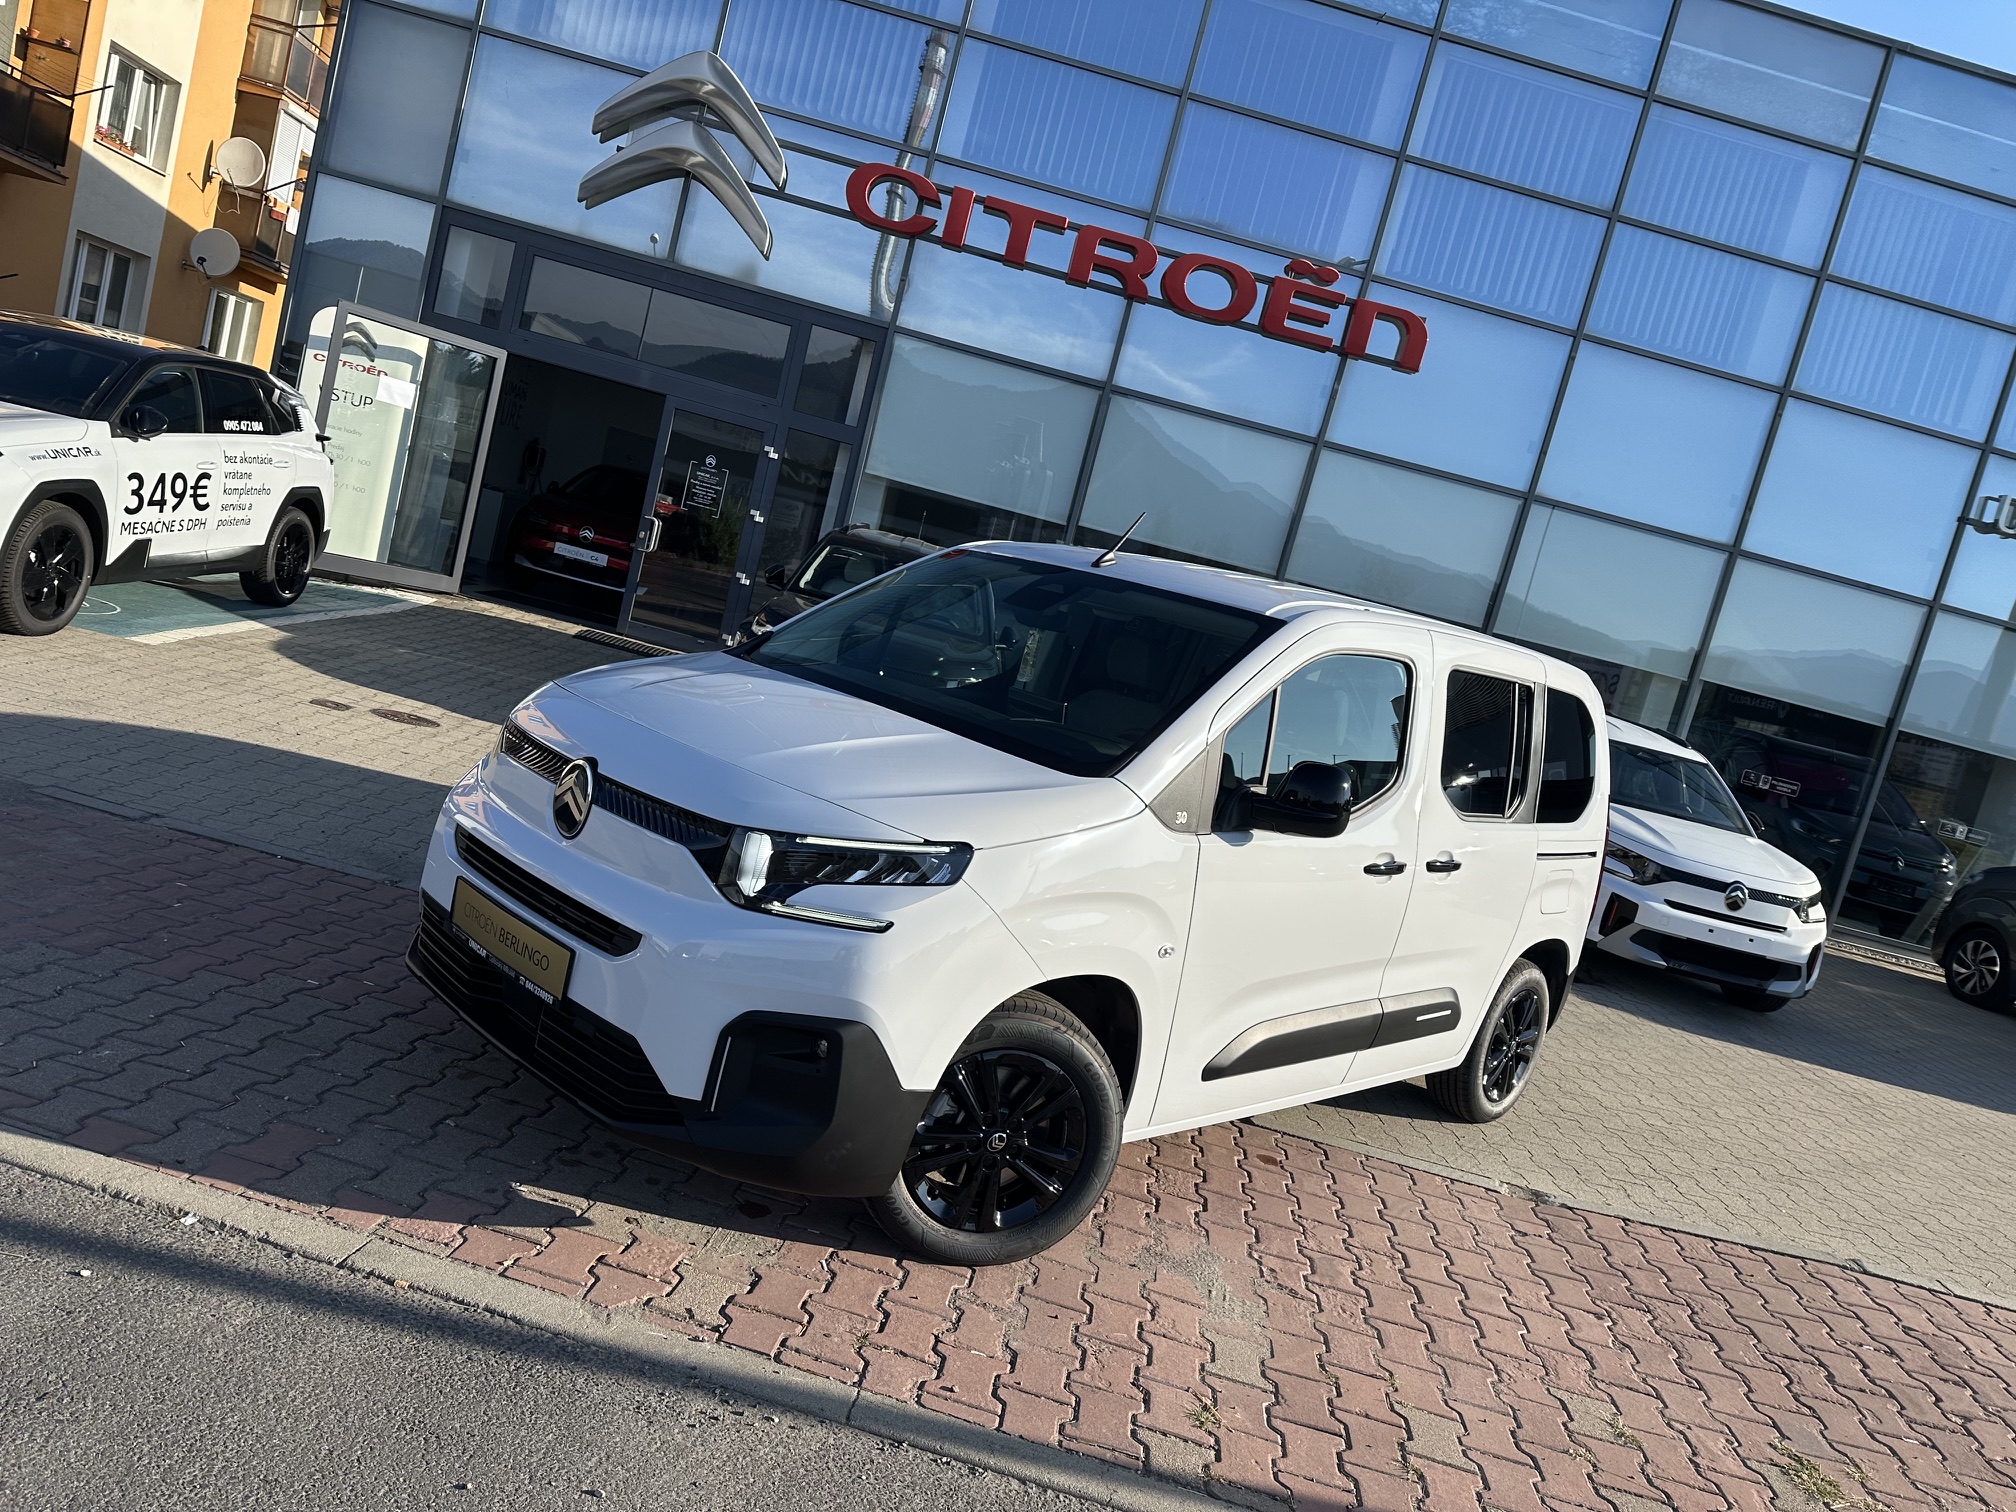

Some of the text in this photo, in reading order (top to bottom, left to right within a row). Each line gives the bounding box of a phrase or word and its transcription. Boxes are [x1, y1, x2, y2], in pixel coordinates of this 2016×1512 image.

[223, 449, 273, 465] bez akontácie
[223, 468, 253, 480] vrátane
[123, 471, 212, 515] 349€
[222, 482, 271, 499] kompletného
[220, 500, 253, 511] servisu a
[120, 517, 207, 535] MESAČNE S DPH
[216, 515, 251, 530] poistenia
[464, 901, 499, 938] CITROËN
[498, 927, 550, 972] BERLINGO
